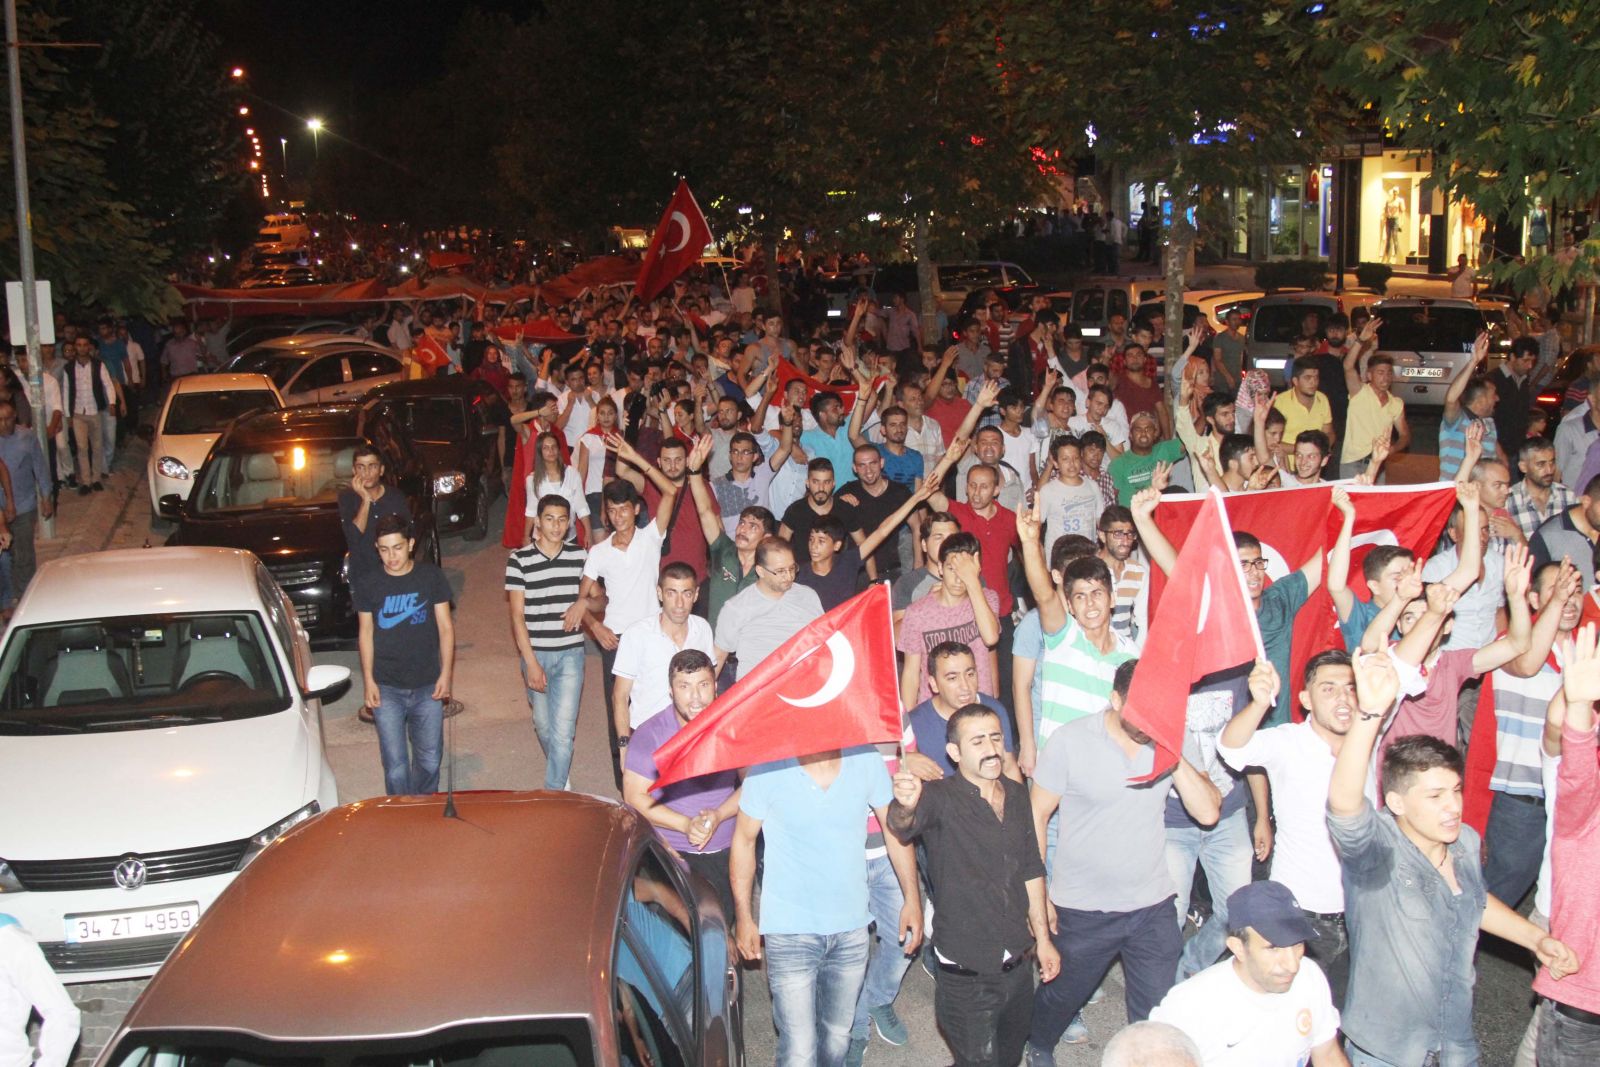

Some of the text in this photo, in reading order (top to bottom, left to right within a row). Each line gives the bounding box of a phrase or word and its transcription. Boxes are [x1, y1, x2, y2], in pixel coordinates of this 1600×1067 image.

[1063, 518, 1080, 532] 53
[383, 592, 419, 614] NIKE
[924, 630, 947, 653] STOP
[79, 910, 191, 939] 34 ZT 4959
